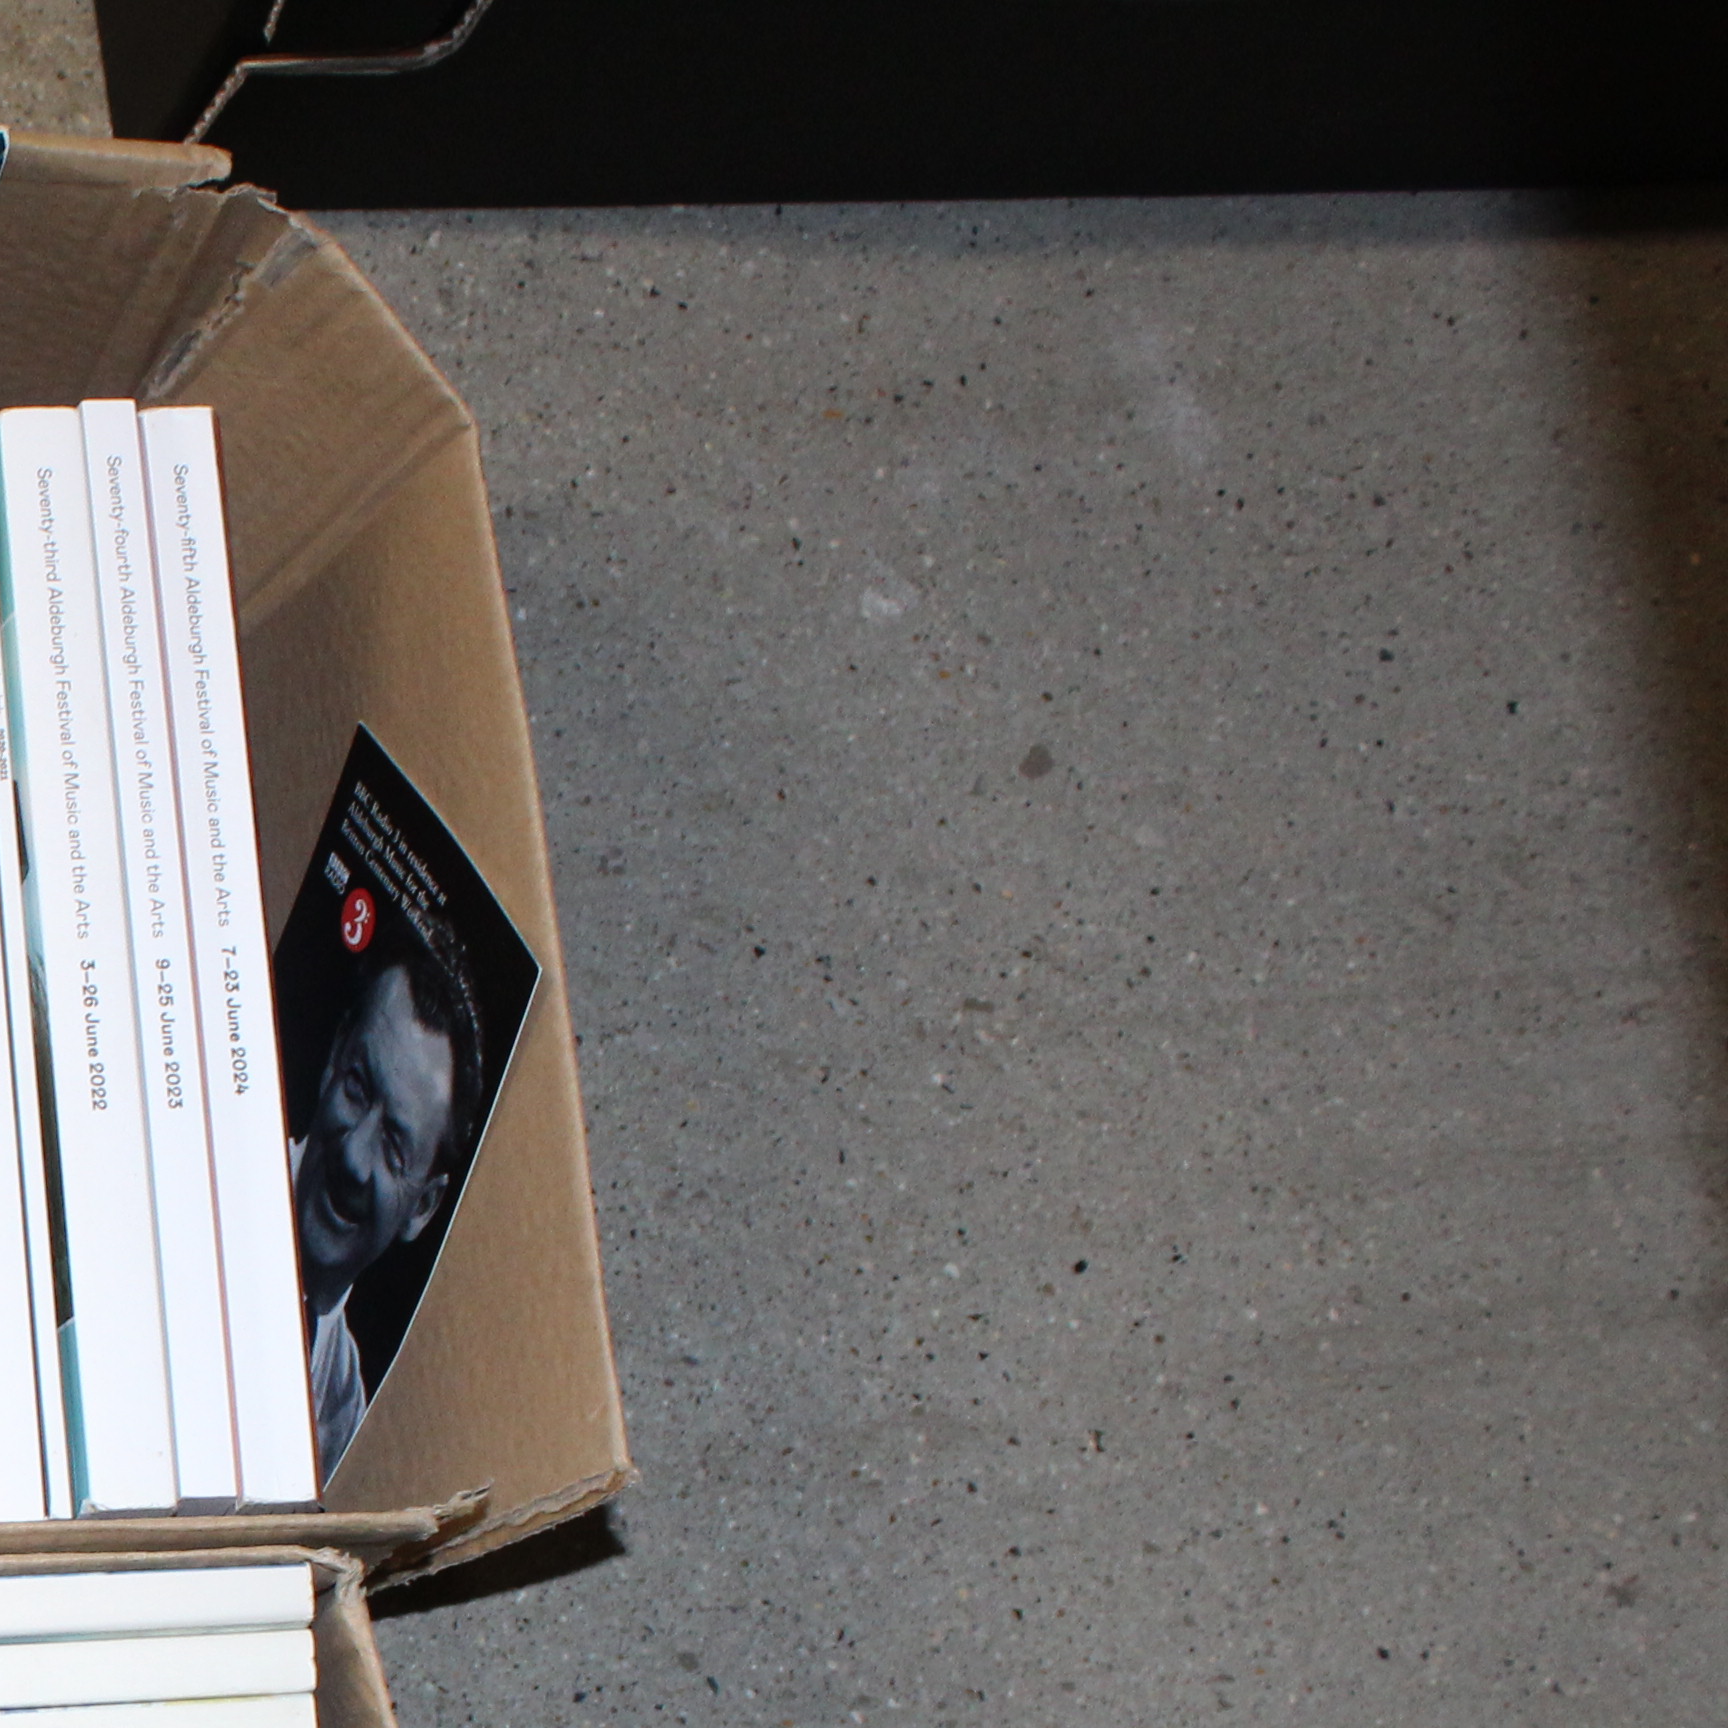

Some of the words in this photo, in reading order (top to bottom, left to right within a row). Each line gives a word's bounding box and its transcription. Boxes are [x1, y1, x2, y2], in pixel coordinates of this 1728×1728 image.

[173, 464, 198, 572] Seventy-fifth
[185, 576, 207, 664] Aldeburgh
[194, 669, 215, 734] Festival
[201, 739, 218, 758] of
[204, 762, 220, 812] Music
[208, 818, 225, 848] and
[212, 853, 227, 882] the
[215, 887, 231, 927] Arts
[221, 946, 240, 993] 7–23
[226, 998, 241, 1042] June
[231, 1047, 249, 1095] 2024
